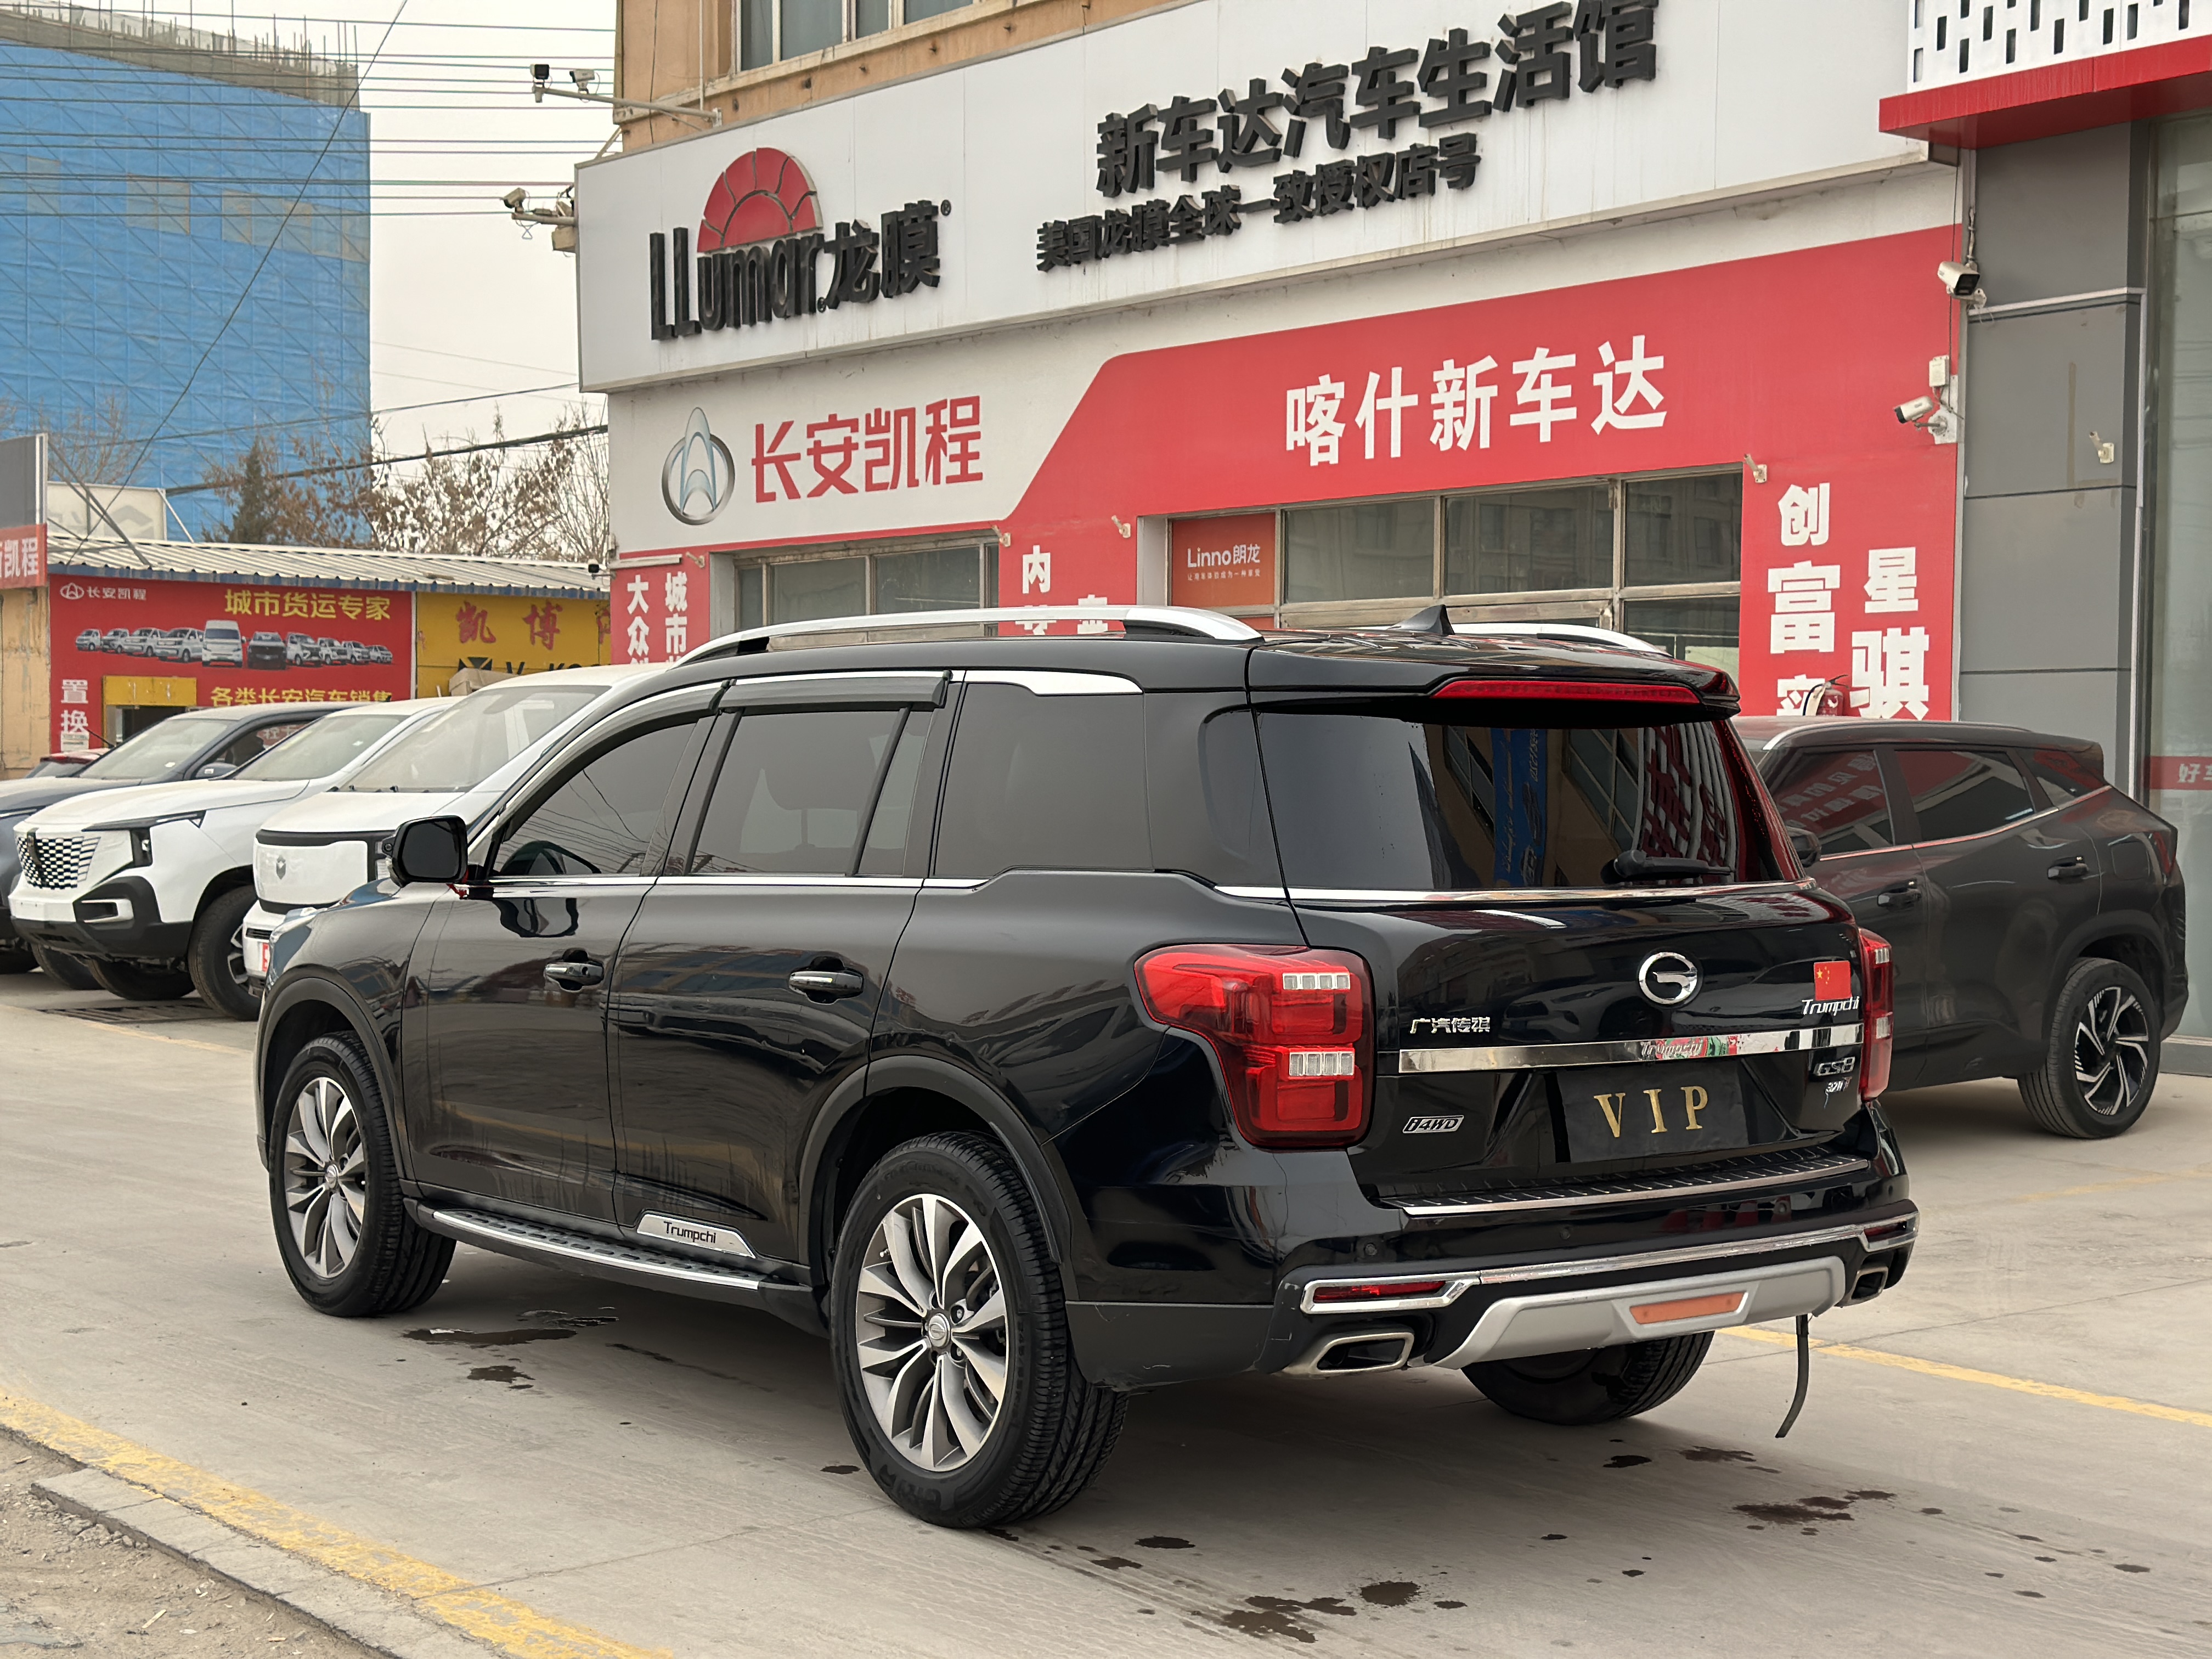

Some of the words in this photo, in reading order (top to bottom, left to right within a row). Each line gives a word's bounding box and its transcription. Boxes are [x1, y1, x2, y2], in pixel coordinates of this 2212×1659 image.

[1096, 0, 1657, 199] 新车达汽车生活馆
[1036, 132, 1481, 272] 美国龙膜全球一致授权店号
[823, 199, 941, 309] 龙膜
[1285, 334, 1668, 467] 喀什新车达
[751, 395, 983, 504] 长安凯程
[0, 536, 38, 579] 凯程
[1187, 546, 1232, 568] Linno
[87, 585, 147, 601] 长安凯程
[224, 589, 391, 621] 城市货运专家
[627, 574, 650, 664] 大众
[665, 571, 688, 663] 城市
[1409, 1017, 1491, 1034] 广汽传祺
[1802, 996, 1860, 1016] Trumpchi
[1814, 1057, 1855, 1076] GS8
[1593, 1086, 1708, 1138] VIP
[663, 1220, 716, 1244] Trumpchi
